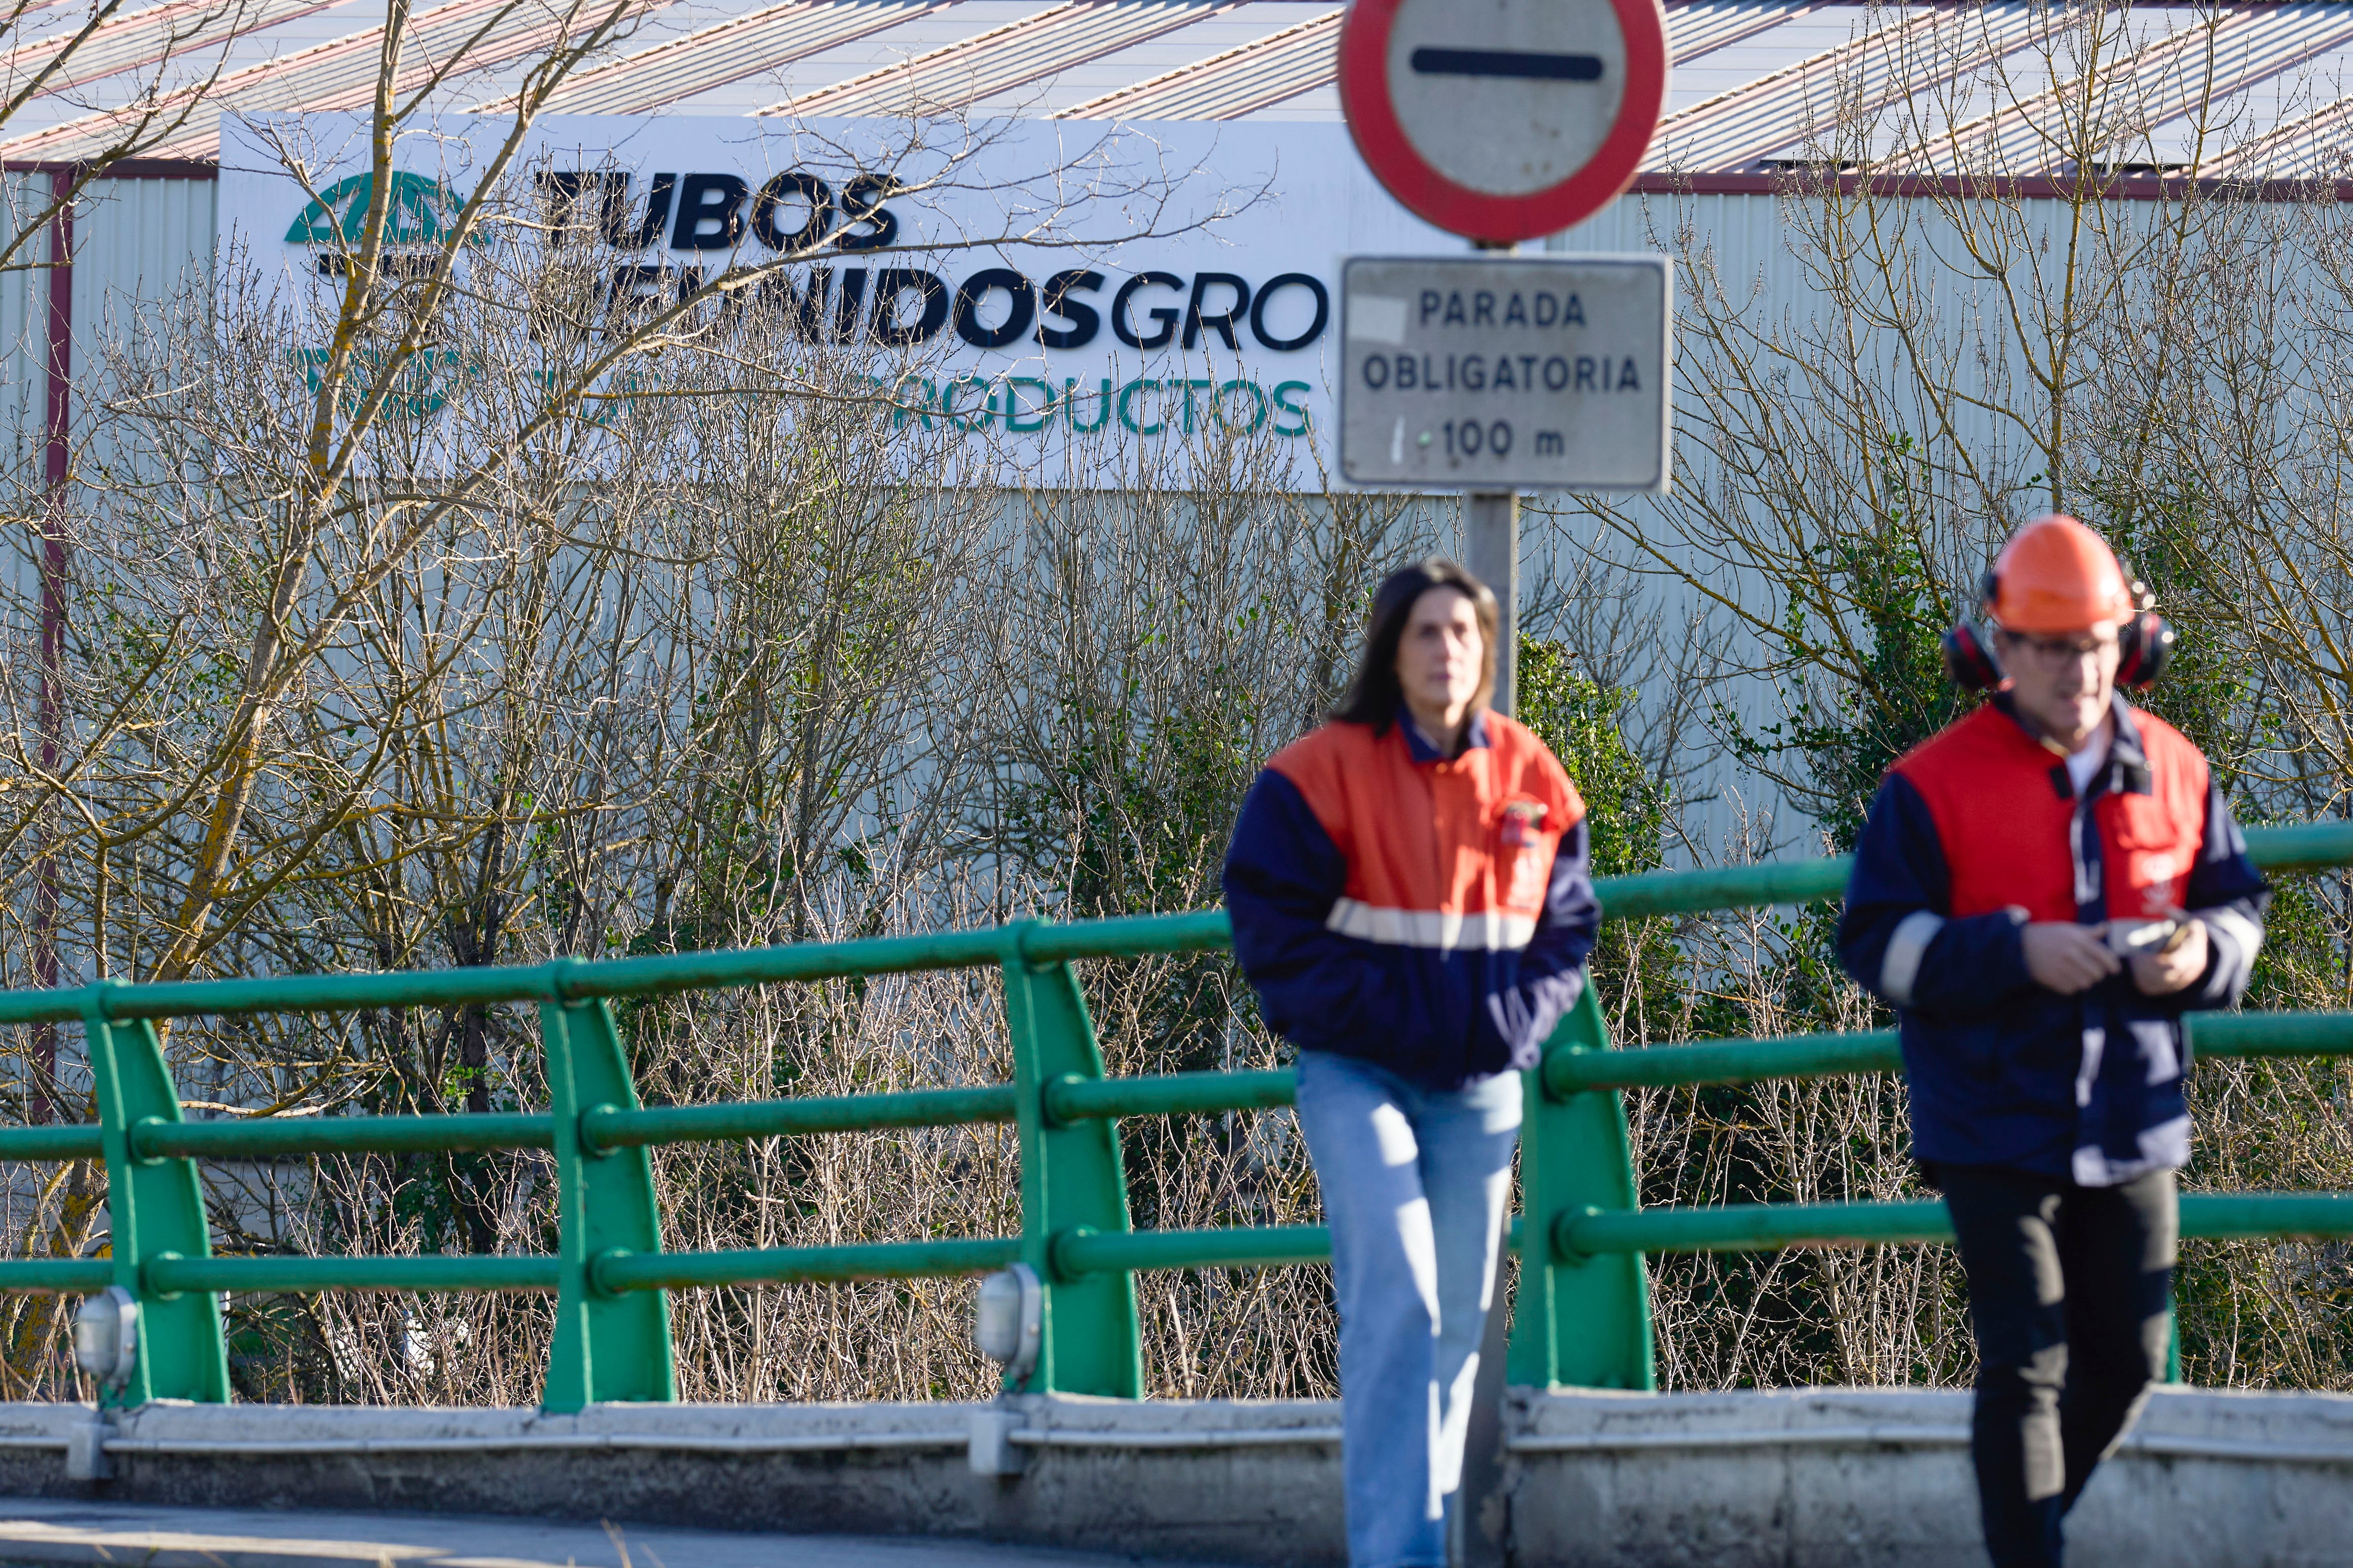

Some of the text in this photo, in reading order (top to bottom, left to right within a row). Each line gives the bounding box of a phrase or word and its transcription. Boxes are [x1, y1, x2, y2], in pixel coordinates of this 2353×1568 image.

[536, 172, 904, 250] TUBOS
[1420, 290, 1587, 328] PARADA
[1362, 354, 1641, 392] OBLIGATORIA
[1442, 418, 1565, 457] 100 m
